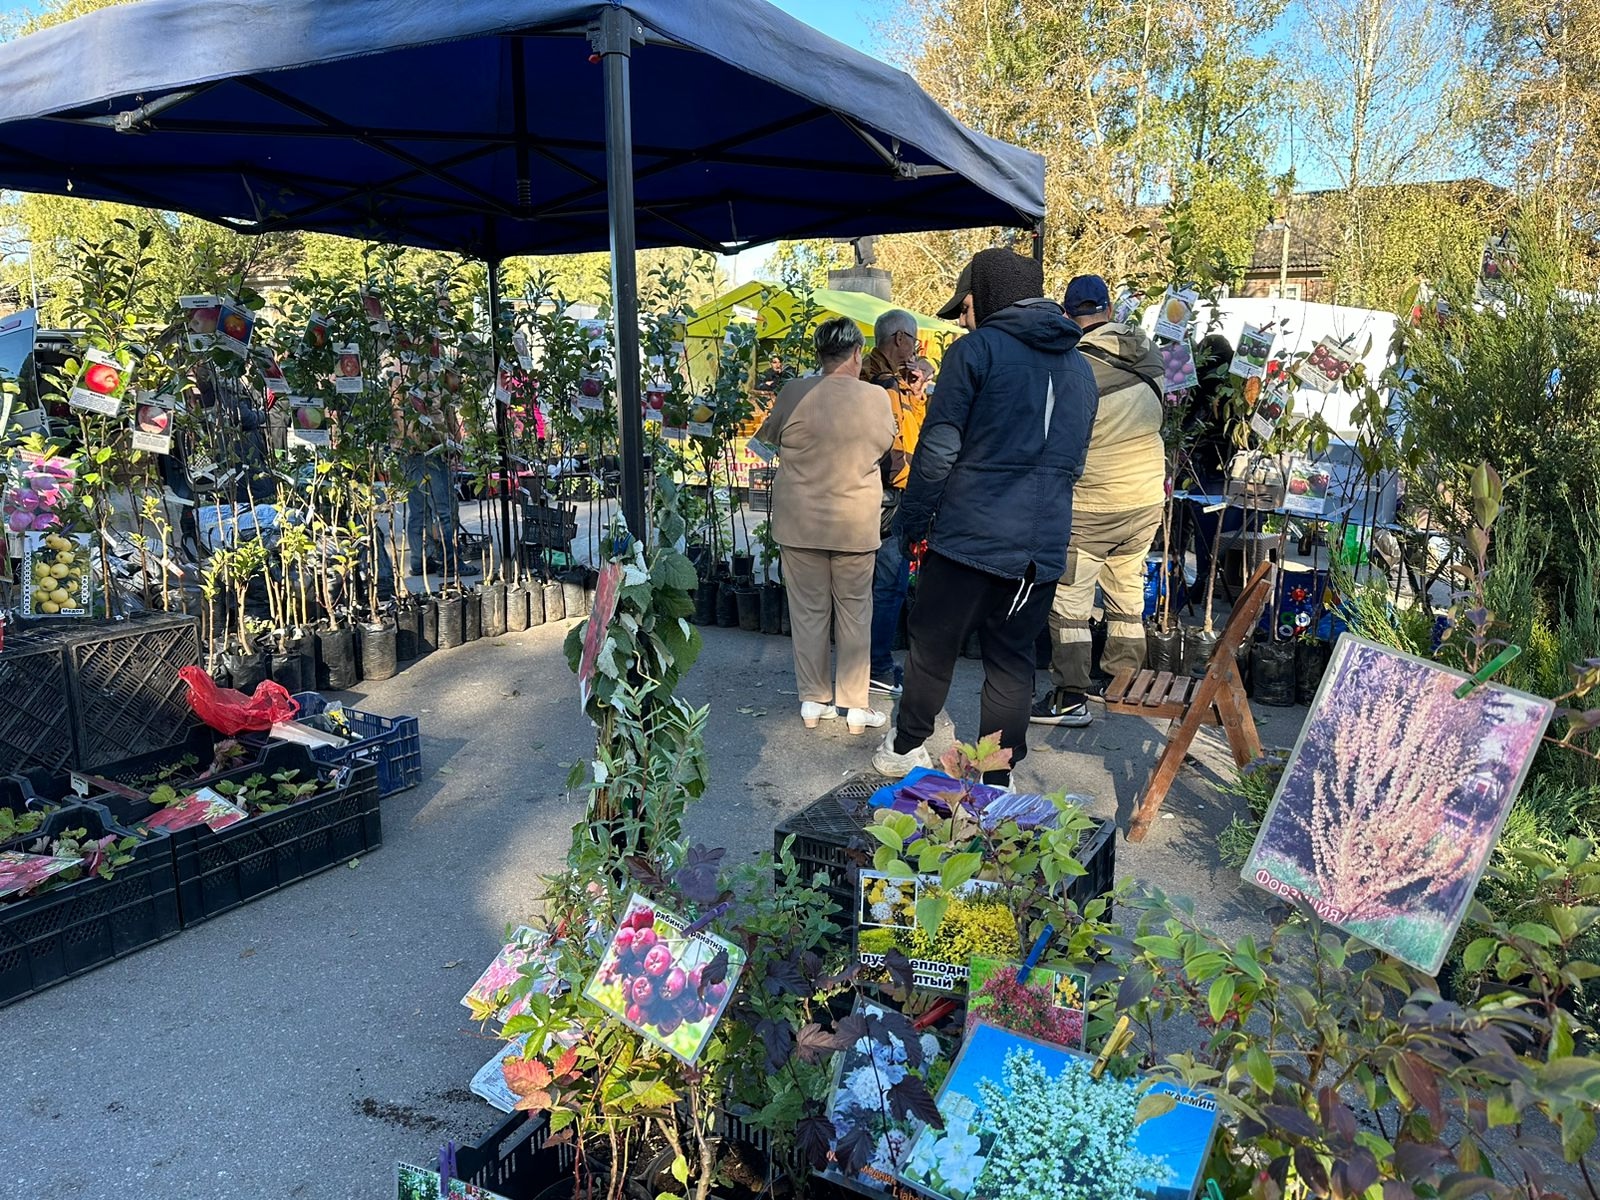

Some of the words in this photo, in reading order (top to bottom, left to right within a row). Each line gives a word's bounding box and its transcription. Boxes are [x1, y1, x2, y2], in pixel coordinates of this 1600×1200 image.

[1256, 869, 1340, 922] Форзция
[655, 911, 685, 931] рябина
[690, 932, 728, 953] ранатная
[914, 974, 952, 988] лтый
